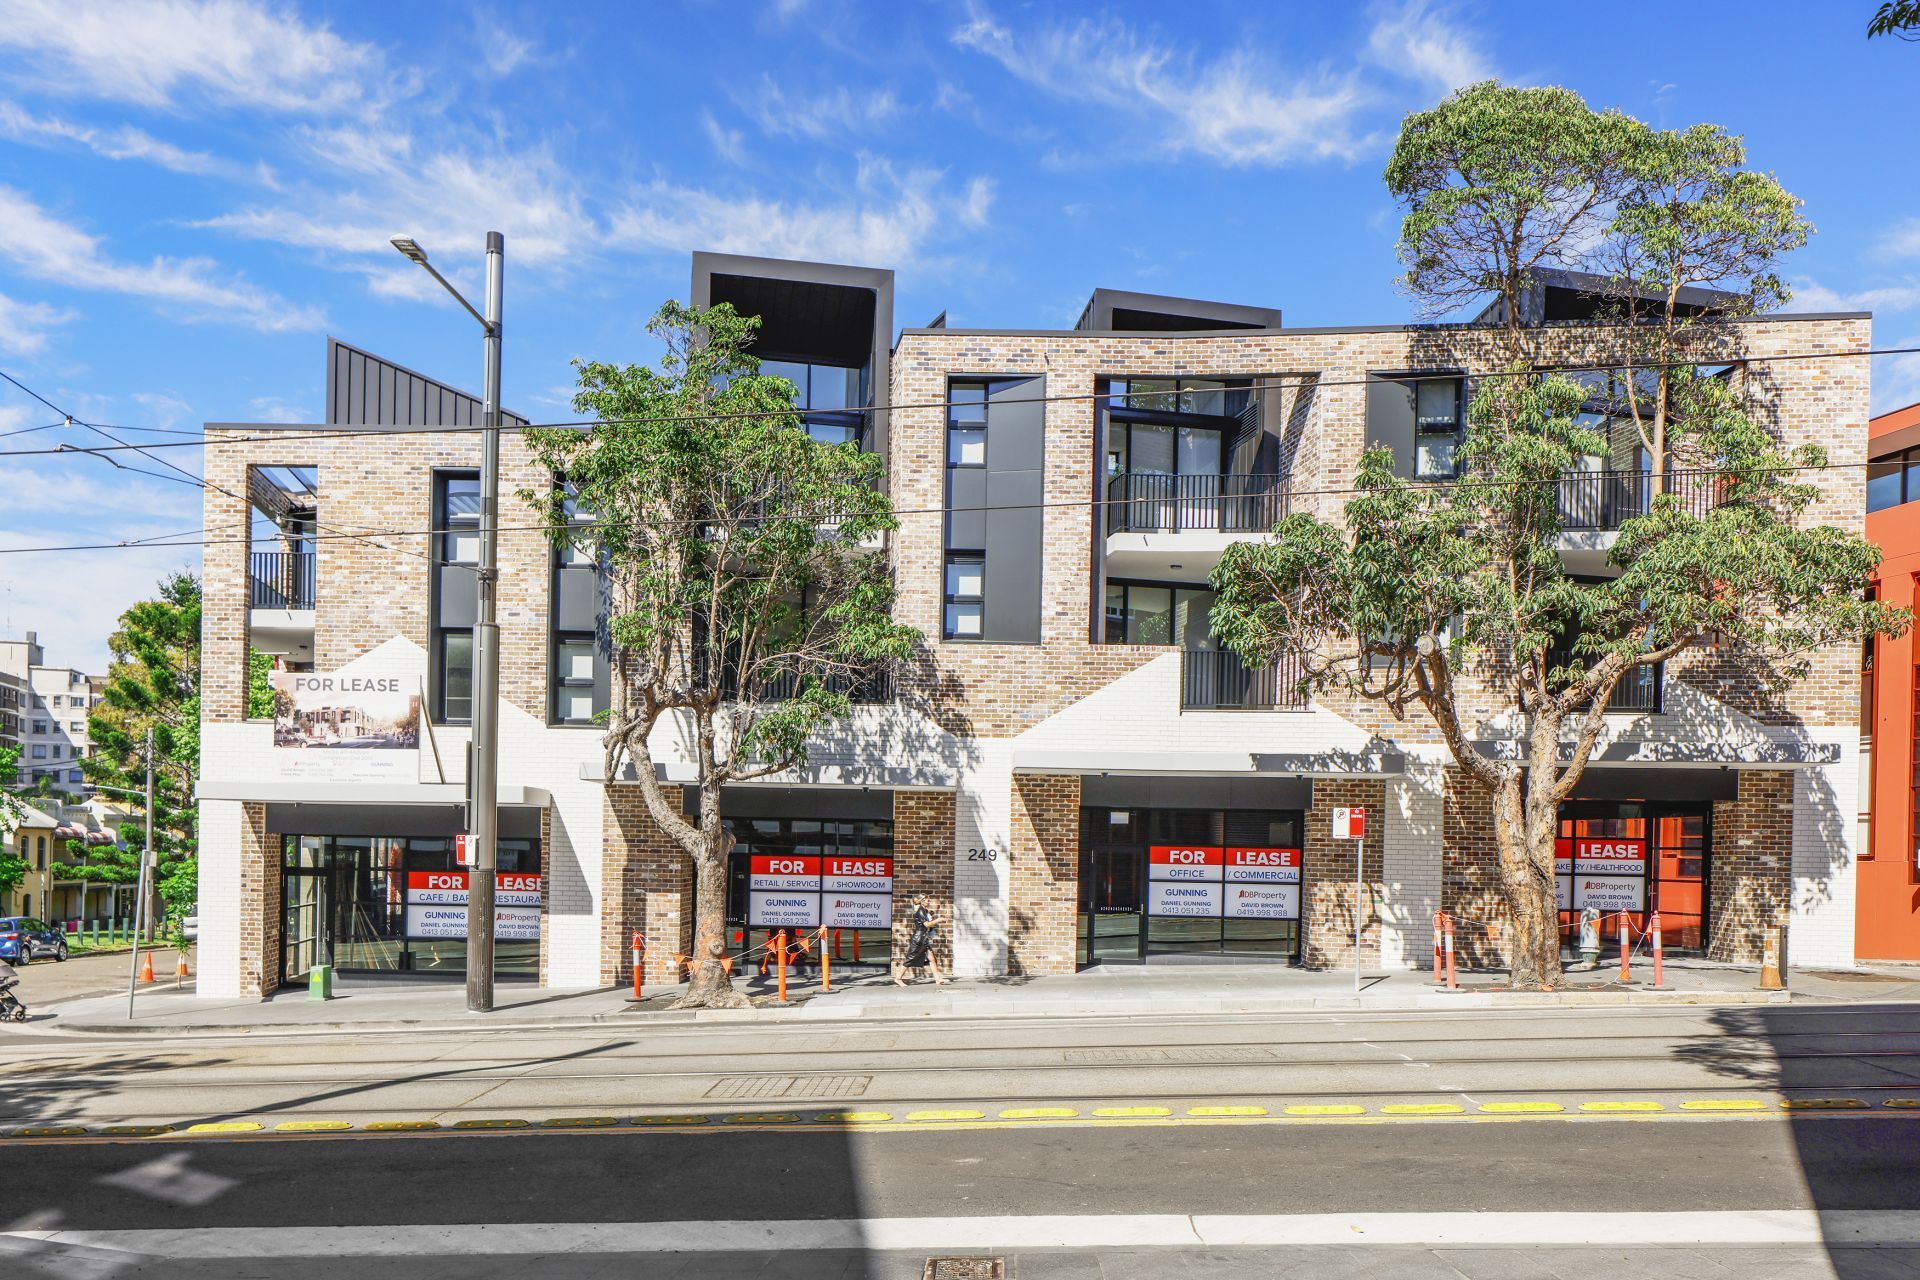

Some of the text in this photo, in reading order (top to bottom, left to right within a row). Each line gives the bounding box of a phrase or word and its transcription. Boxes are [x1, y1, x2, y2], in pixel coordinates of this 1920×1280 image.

[296, 678, 399, 692] FOR LEASE
[968, 849, 997, 861] 249
[1581, 844, 1638, 858] LEASE
[1170, 851, 1291, 865] FOR LEASE
[770, 861, 885, 875] FOR LEASE
[1590, 864, 1642, 872] HEALTHFOOD
[1170, 870, 1205, 878] OFFICE
[1234, 871, 1298, 880] COMMERCIAL
[429, 876, 462, 889] FOR
[787, 880, 819, 888] SERVICE
[1591, 883, 1636, 891] DBProperty
[1166, 889, 1208, 897] GUNNING
[1245, 891, 1287, 900] DBProperty
[496, 896, 540, 904] ESTAURA
[766, 899, 807, 907] GUNNING
[841, 900, 881, 910] DBProperty
[425, 912, 465, 920] GUNNING
